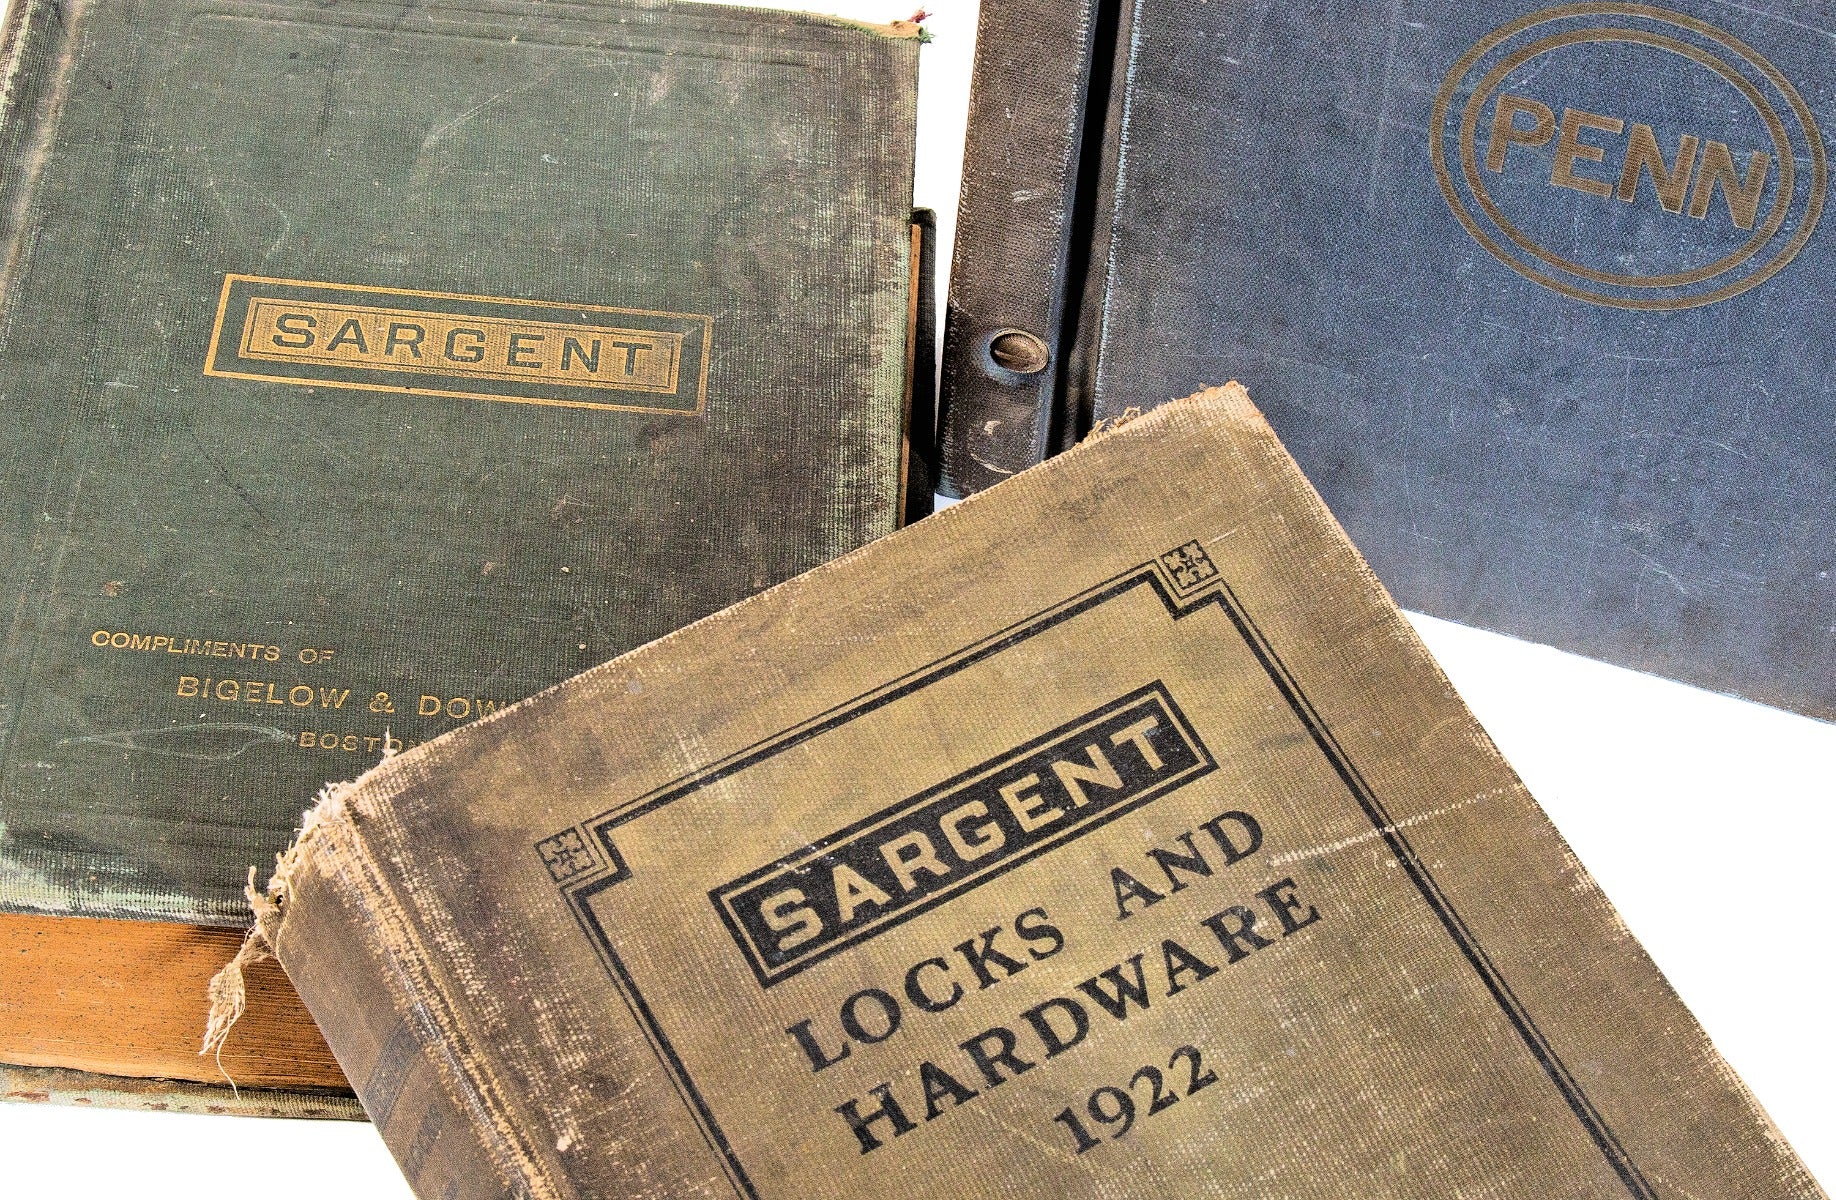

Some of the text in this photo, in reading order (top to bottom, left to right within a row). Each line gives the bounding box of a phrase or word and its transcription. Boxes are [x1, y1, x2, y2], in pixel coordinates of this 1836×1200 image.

[1486, 94, 1770, 230] PENN
[272, 312, 652, 376] SARGENT
[91, 630, 334, 664] COMPLIMENTS OF
[177, 675, 350, 709] BIGELOW
[369, 692, 395, 713] &
[759, 718, 1168, 951] SARGENT
[786, 809, 1264, 1073] LOCKS AND
[834, 876, 1322, 1156] HARDWARE
[1054, 1043, 1219, 1154] 1922
